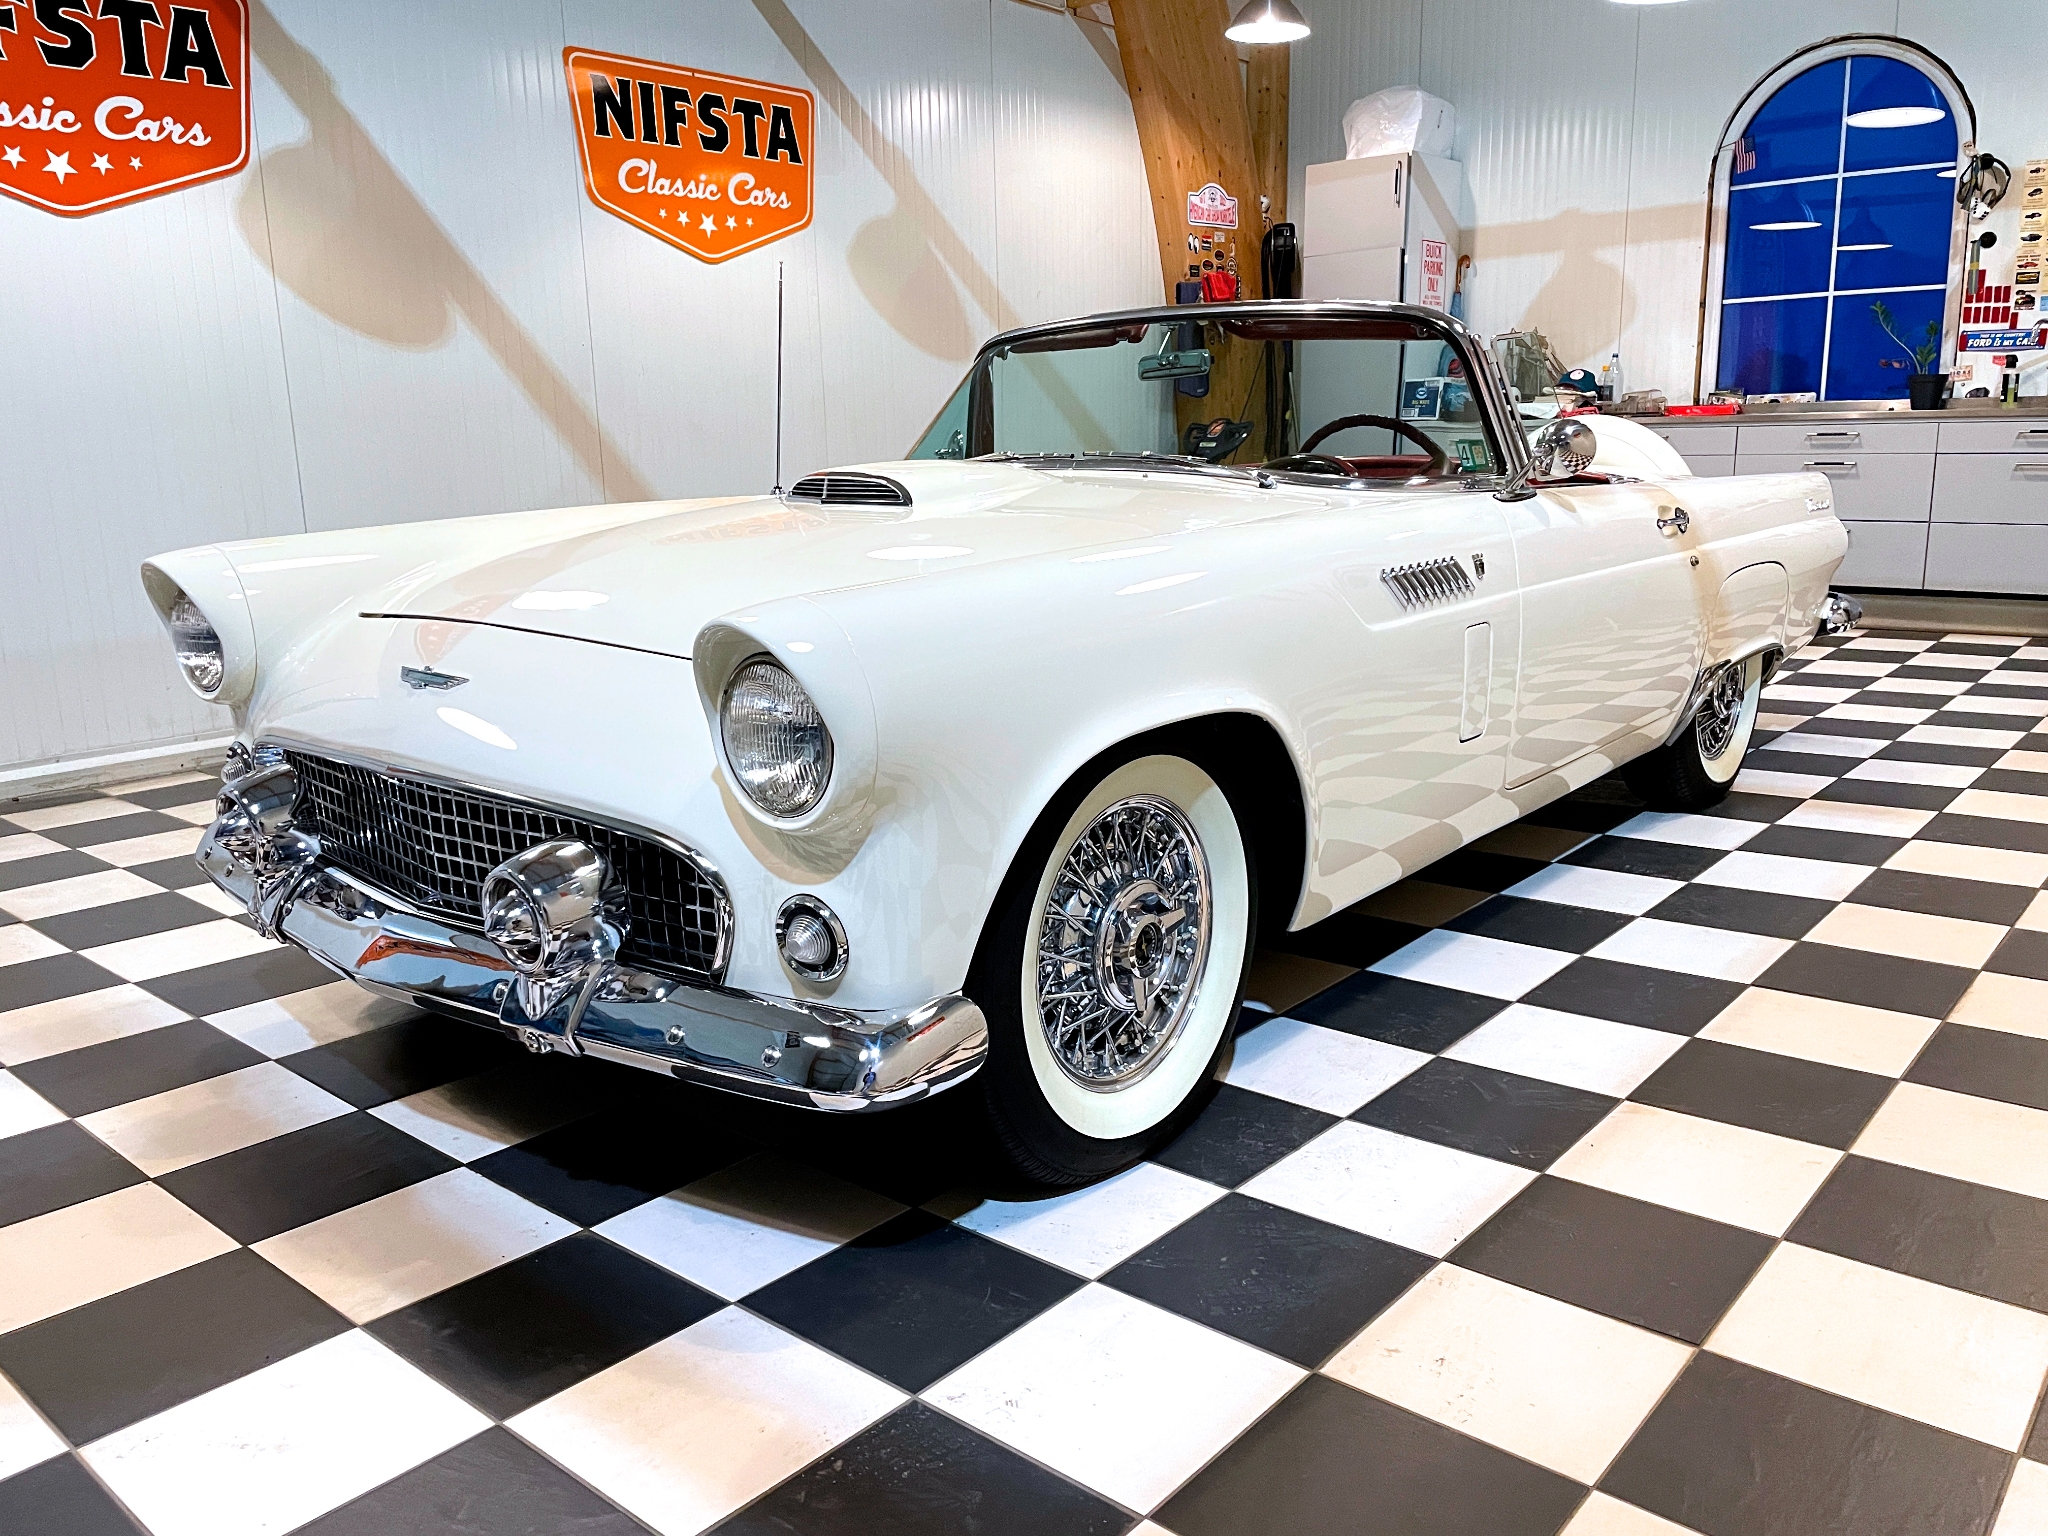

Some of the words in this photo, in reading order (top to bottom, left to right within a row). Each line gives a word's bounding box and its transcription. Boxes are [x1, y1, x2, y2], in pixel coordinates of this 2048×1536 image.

[94, 95, 212, 147] Cars
[589, 73, 804, 165] NIFSTA
[618, 158, 721, 201] Classic
[728, 172, 791, 209] Cars
[1426, 244, 1442, 258] BUICK
[1424, 260, 1443, 276] PARKING
[1427, 277, 1438, 292] ONLY
[1967, 338, 1992, 347] FORD
